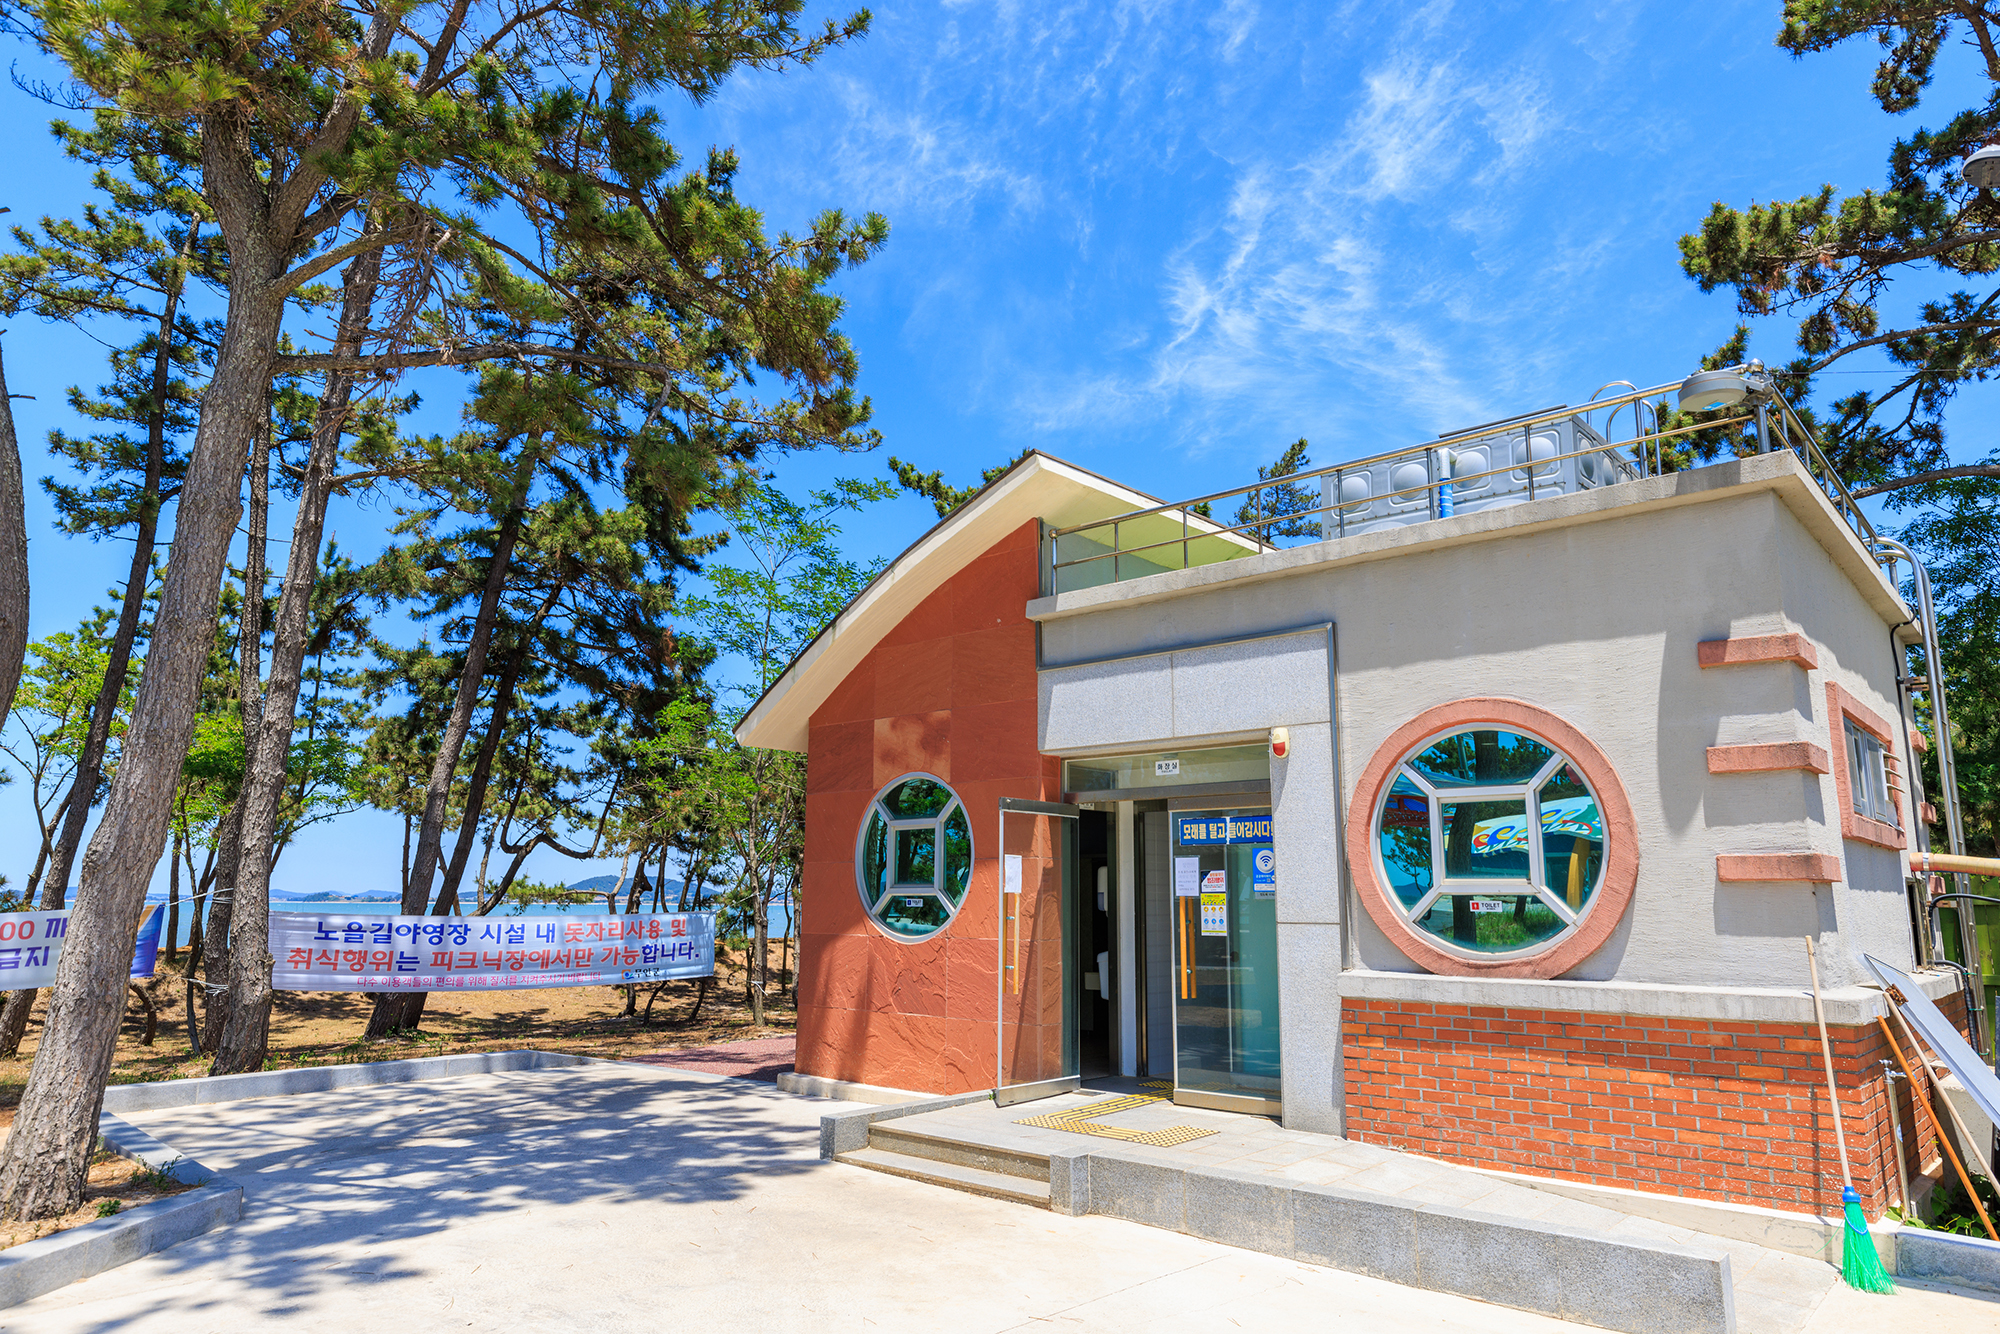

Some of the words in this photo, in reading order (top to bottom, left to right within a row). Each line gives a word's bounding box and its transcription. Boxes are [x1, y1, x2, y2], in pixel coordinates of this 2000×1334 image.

[1157, 762, 1178, 770] 화장실
[1184, 823, 1207, 839] 모래를
[1210, 823, 1226, 839] 털고
[313, 921, 472, 946] 노을길야영장
[479, 922, 526, 945] 시설
[536, 922, 556, 944] 내
[564, 919, 663, 944] 돗자리사용
[670, 917, 687, 937] 및
[0, 946, 50, 970] 금지
[286, 947, 421, 972] 취식행위는
[429, 947, 594, 972] 피크닉장에서만
[599, 940, 700, 966] 가능합니다.
[356, 976, 378, 988] 다수
[381, 976, 432, 988] 이용객들의
[435, 976, 465, 988] 편의를
[467, 976, 488, 987] 위해
[490, 975, 518, 987] 질서를
[520, 972, 566, 986] 지켜주시기
[568, 970, 604, 983] 바랍니다.
[635, 967, 660, 979] 무안군
